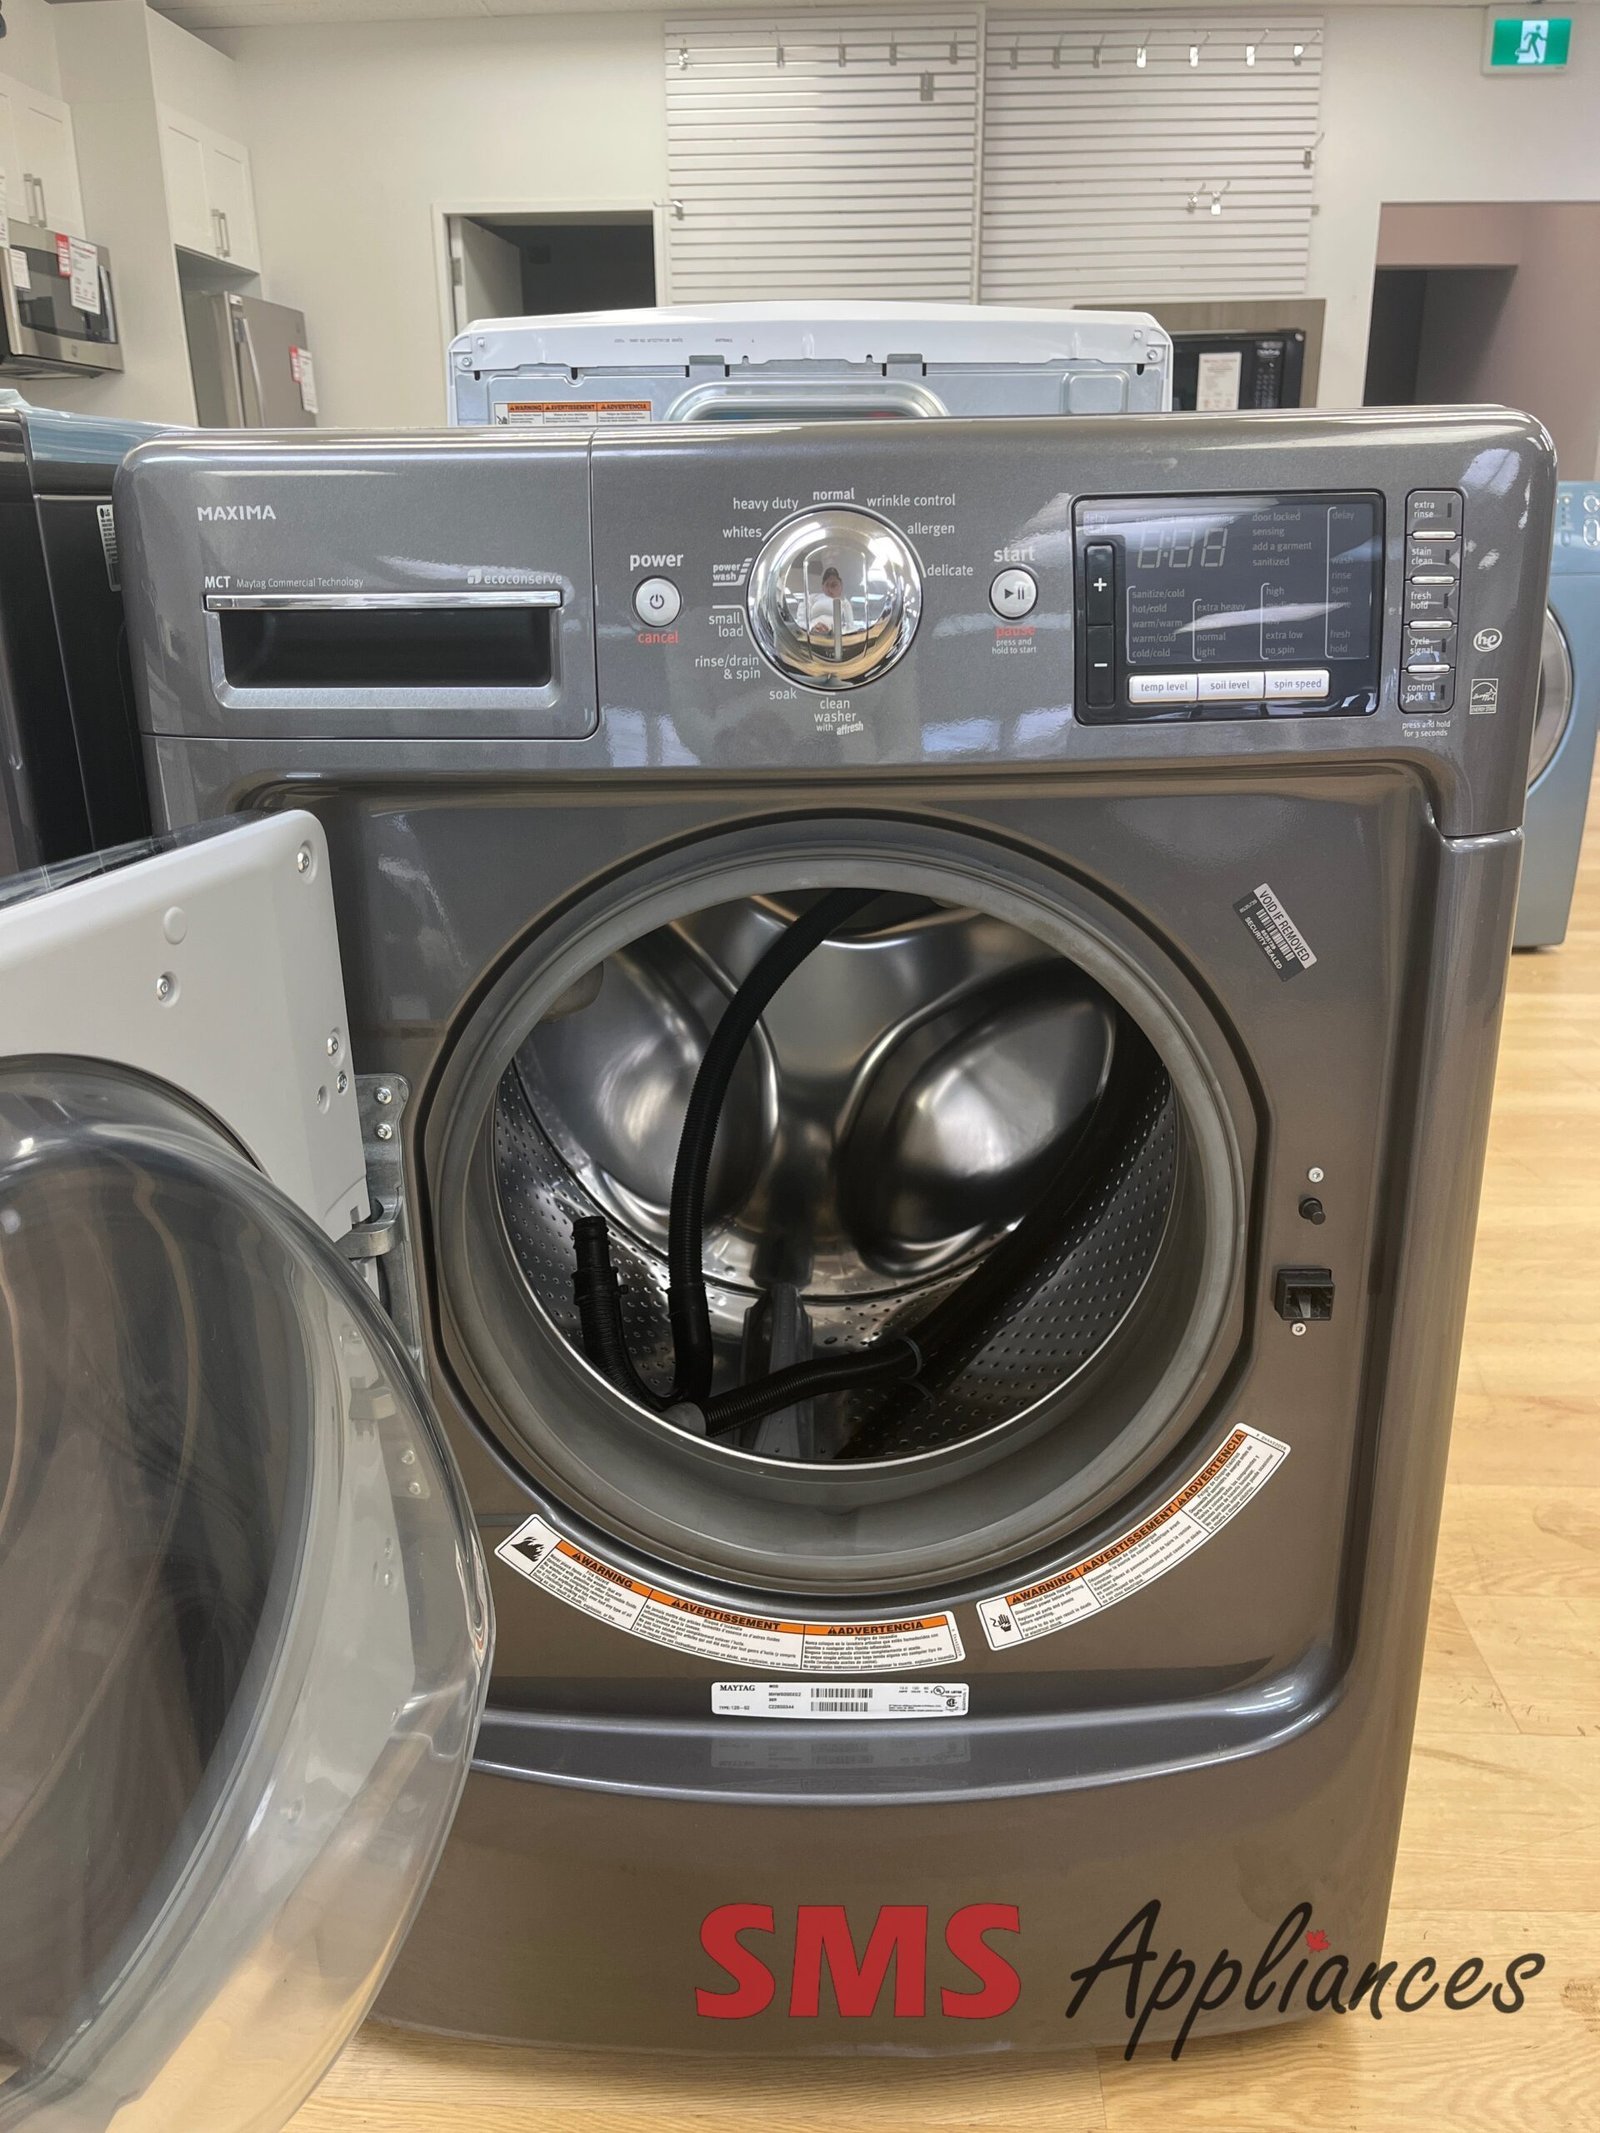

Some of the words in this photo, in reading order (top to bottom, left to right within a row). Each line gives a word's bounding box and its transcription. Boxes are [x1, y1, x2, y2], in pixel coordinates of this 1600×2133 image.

[813, 488, 855, 500] normal
[733, 498, 768, 512] heavy
[772, 498, 799, 511] duty
[867, 494, 911, 507] wrinkle
[914, 494, 956, 506] control
[197, 505, 276, 520] MAXIMA
[1252, 512, 1271, 521] door
[1274, 512, 1300, 520] locked
[1332, 512, 1354, 520] delay
[1414, 510, 1434, 518] rinse
[723, 526, 762, 538] whites
[907, 523, 955, 536] allergen
[1253, 528, 1284, 537] sensing
[1253, 542, 1267, 550] add
[1277, 542, 1312, 551] garment
[994, 546, 1035, 562] start
[1412, 548, 1432, 556] stain
[630, 553, 683, 571] power
[1253, 557, 1289, 566] sanitized
[713, 563, 740, 573] power
[927, 564, 973, 576] delicate
[484, 575, 562, 584] ecoconserve
[713, 573, 737, 581] wash
[1332, 571, 1351, 579] rinse
[205, 576, 231, 588] MCT
[237, 579, 266, 589] Maytag
[268, 577, 315, 587] Commercial
[318, 577, 363, 588] Technology
[1132, 589, 1184, 598] sanitize/cold
[1266, 587, 1284, 597] high
[1332, 585, 1348, 594] spin
[1411, 592, 1431, 600] fresh
[1133, 604, 1167, 613] hot/cold
[1221, 603, 1246, 612] heavy
[1411, 601, 1428, 609] hold
[709, 613, 740, 624] small
[1132, 619, 1182, 628] warm/warm
[719, 625, 743, 637] load
[995, 626, 1036, 638] pause
[1331, 630, 1350, 638] fresh
[638, 632, 678, 644] cancel
[996, 638, 1016, 646] press
[1132, 633, 1175, 643] warm/cold
[1197, 633, 1226, 641] normal
[1410, 638, 1429, 647] cycle
[1132, 649, 1170, 657] cold/cold
[1197, 648, 1215, 657] light
[1280, 646, 1294, 655] spin
[1330, 644, 1347, 652] hold
[1410, 646, 1433, 655] signal
[695, 655, 759, 667] rinse/drain
[724, 669, 732, 679] &
[737, 668, 761, 681] spin
[1141, 682, 1164, 692] temp
[1167, 681, 1188, 690] level
[1210, 680, 1226, 689] soil
[1229, 680, 1249, 689] level
[1274, 679, 1293, 689] spin
[1295, 679, 1322, 689] speed
[1408, 683, 1434, 691] control
[770, 688, 797, 700] soak
[820, 698, 849, 709] clean
[814, 710, 856, 722] washer
[816, 723, 833, 732] with
[837, 721, 863, 736] affresh
[1402, 722, 1420, 730] press
[1260, 890, 1276, 912] VOID
[1273, 912, 1285, 921] IF
[1279, 920, 1309, 962] REMOVED
[1245, 917, 1266, 946] SECURITY
[1264, 945, 1282, 969] SEALED
[1185, 1434, 1244, 1499] ADVERTENCIA
[1091, 1506, 1174, 1568] AVERTISSEMENT
[580, 1558, 633, 1588] WARNING
[1020, 1573, 1075, 1599] WARNING
[679, 1603, 780, 1630] AVERTISSEMENT
[840, 1621, 923, 1634] ADVERTENCIA
